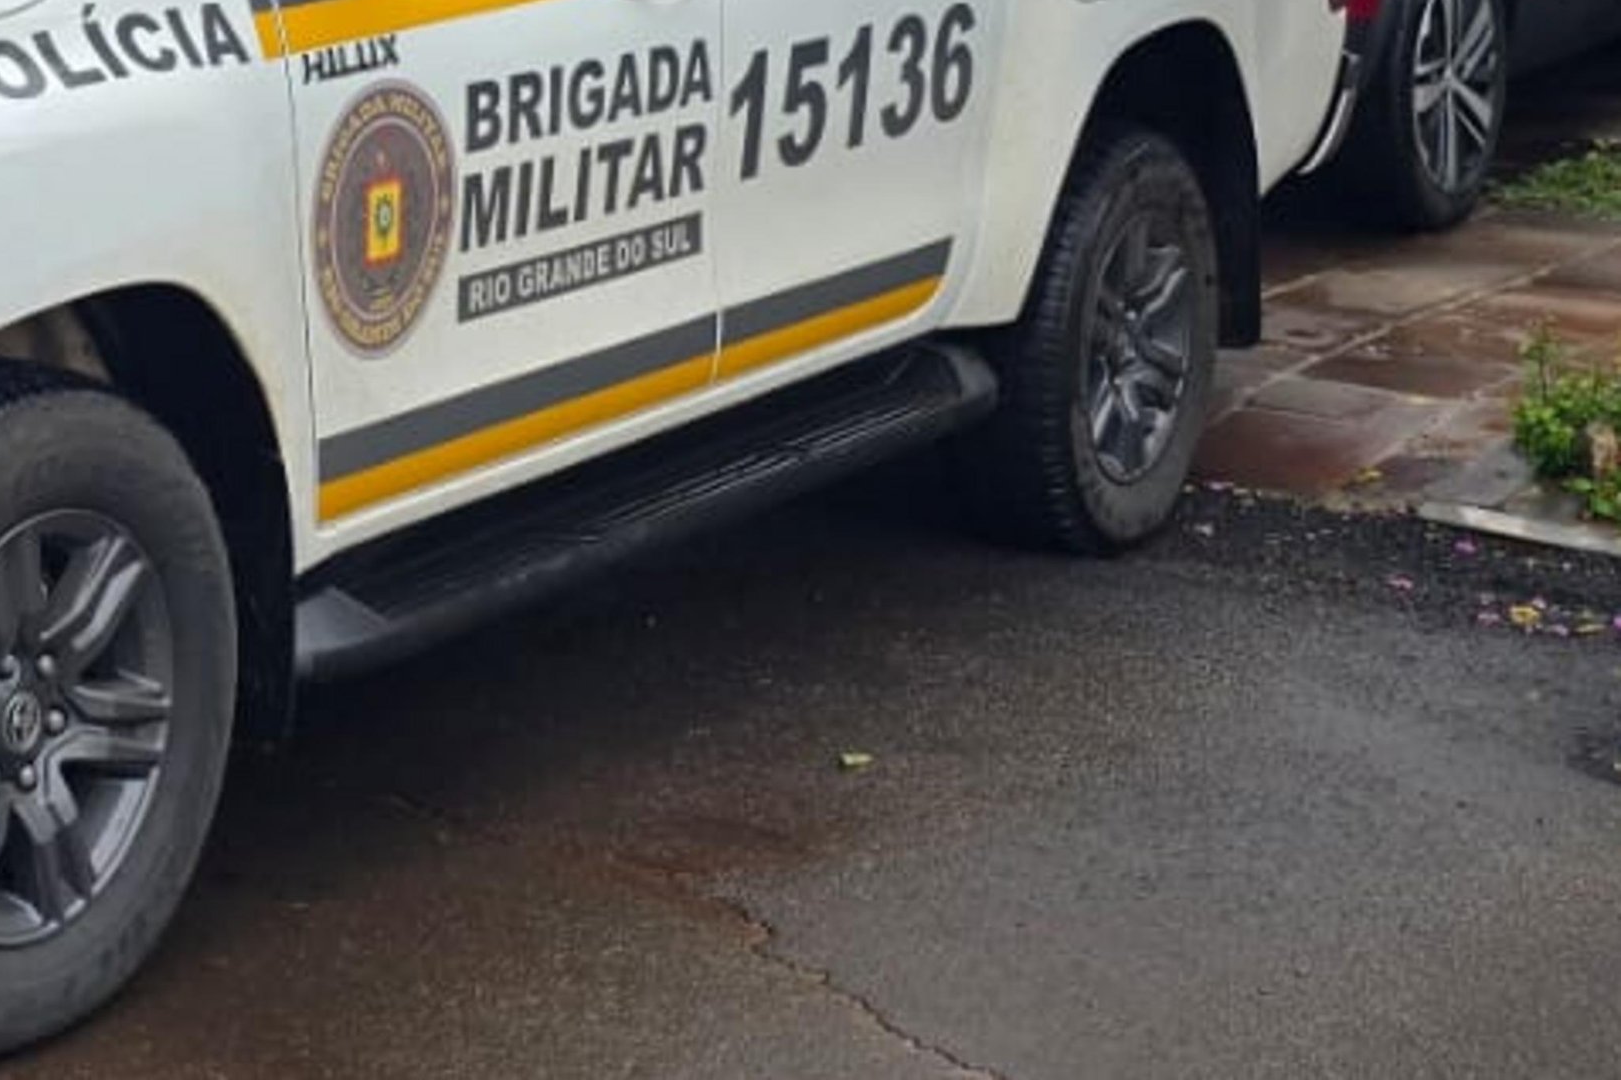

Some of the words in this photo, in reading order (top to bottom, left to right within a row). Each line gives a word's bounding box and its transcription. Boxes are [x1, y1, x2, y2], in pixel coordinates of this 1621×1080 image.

[301, 32, 400, 85] HILUX
[465, 38, 713, 155] BRIGADA
[728, 2, 976, 182] 15136
[459, 122, 706, 253] MILITAR
[469, 273, 511, 314] RIO
[517, 244, 610, 298] GRANDE
[615, 235, 646, 270] DO
[650, 222, 691, 260] SUL
